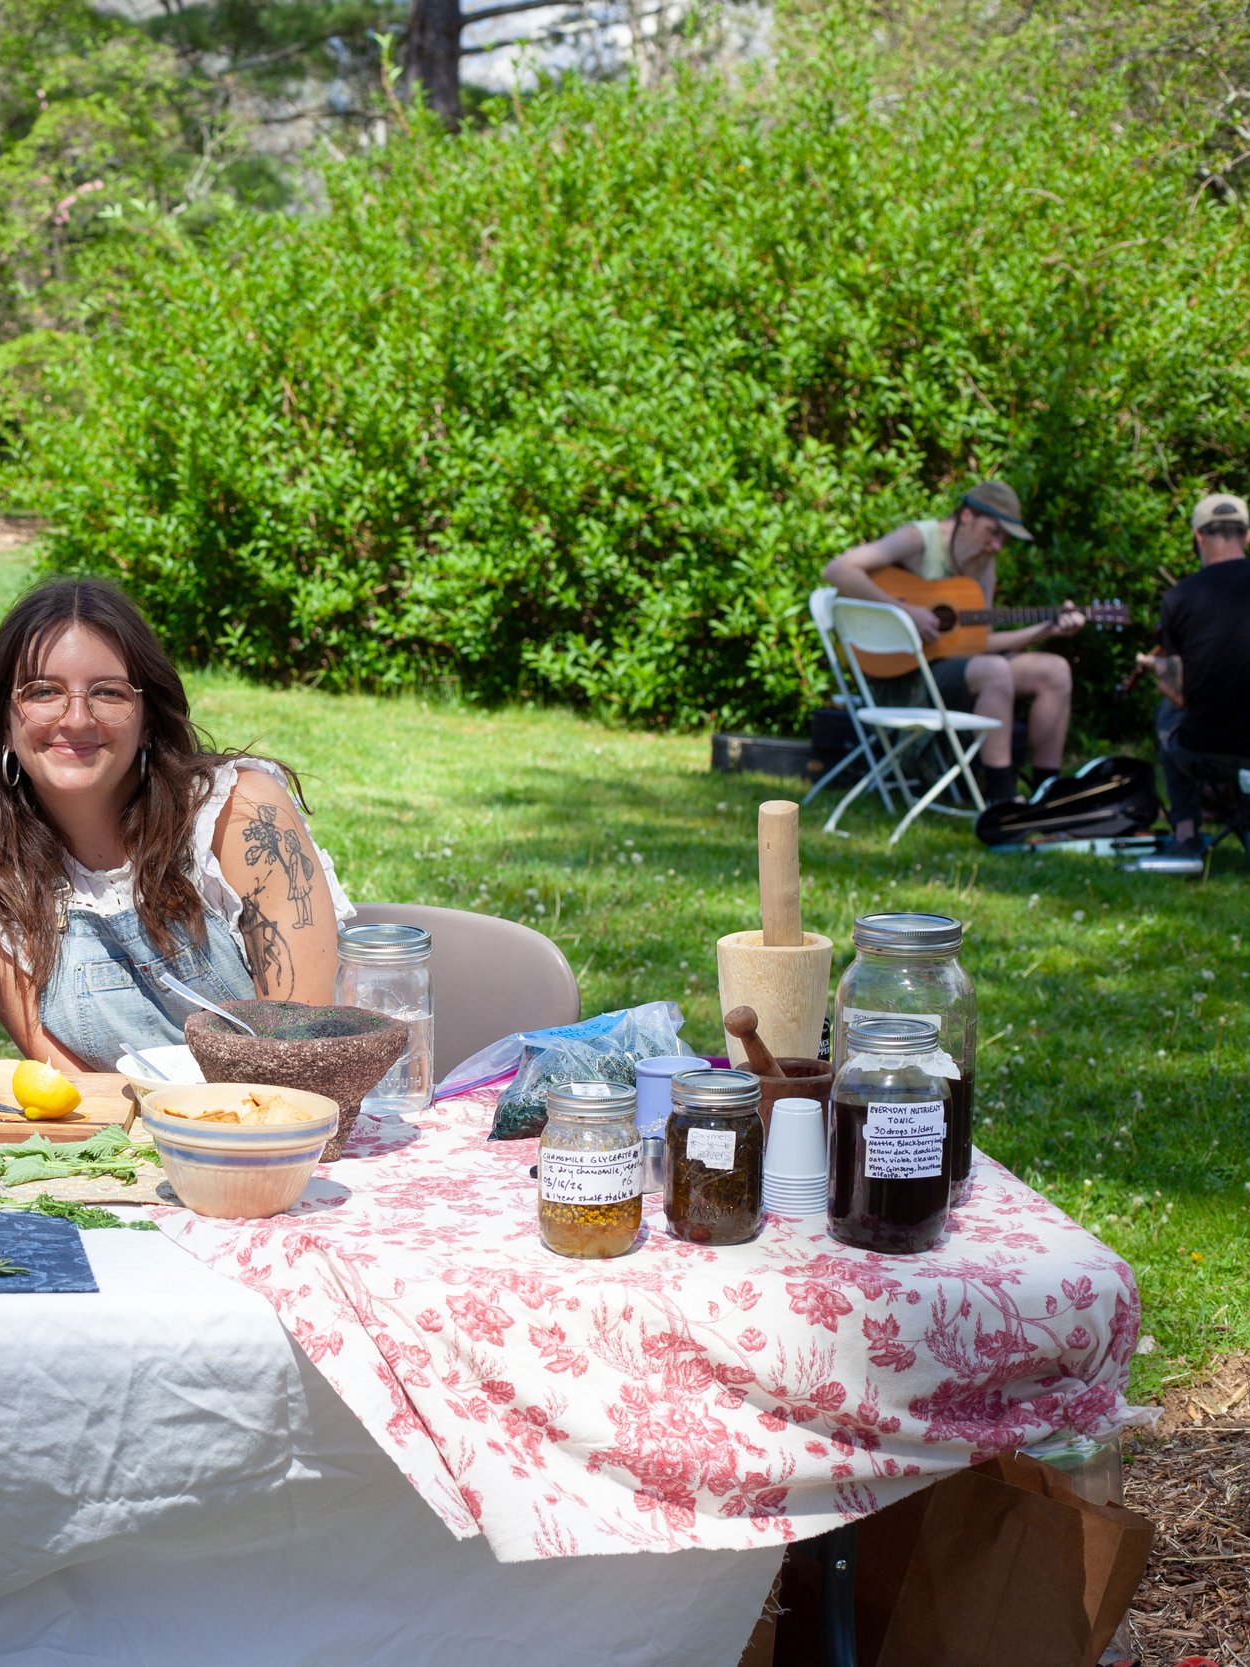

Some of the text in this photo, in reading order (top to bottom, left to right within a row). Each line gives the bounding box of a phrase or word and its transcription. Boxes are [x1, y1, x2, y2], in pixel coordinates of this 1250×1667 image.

[870, 1104, 941, 1114] EVERYDAY NUTRIENT
[543, 1150, 632, 1164] CHAMOMILE GLYCERITE
